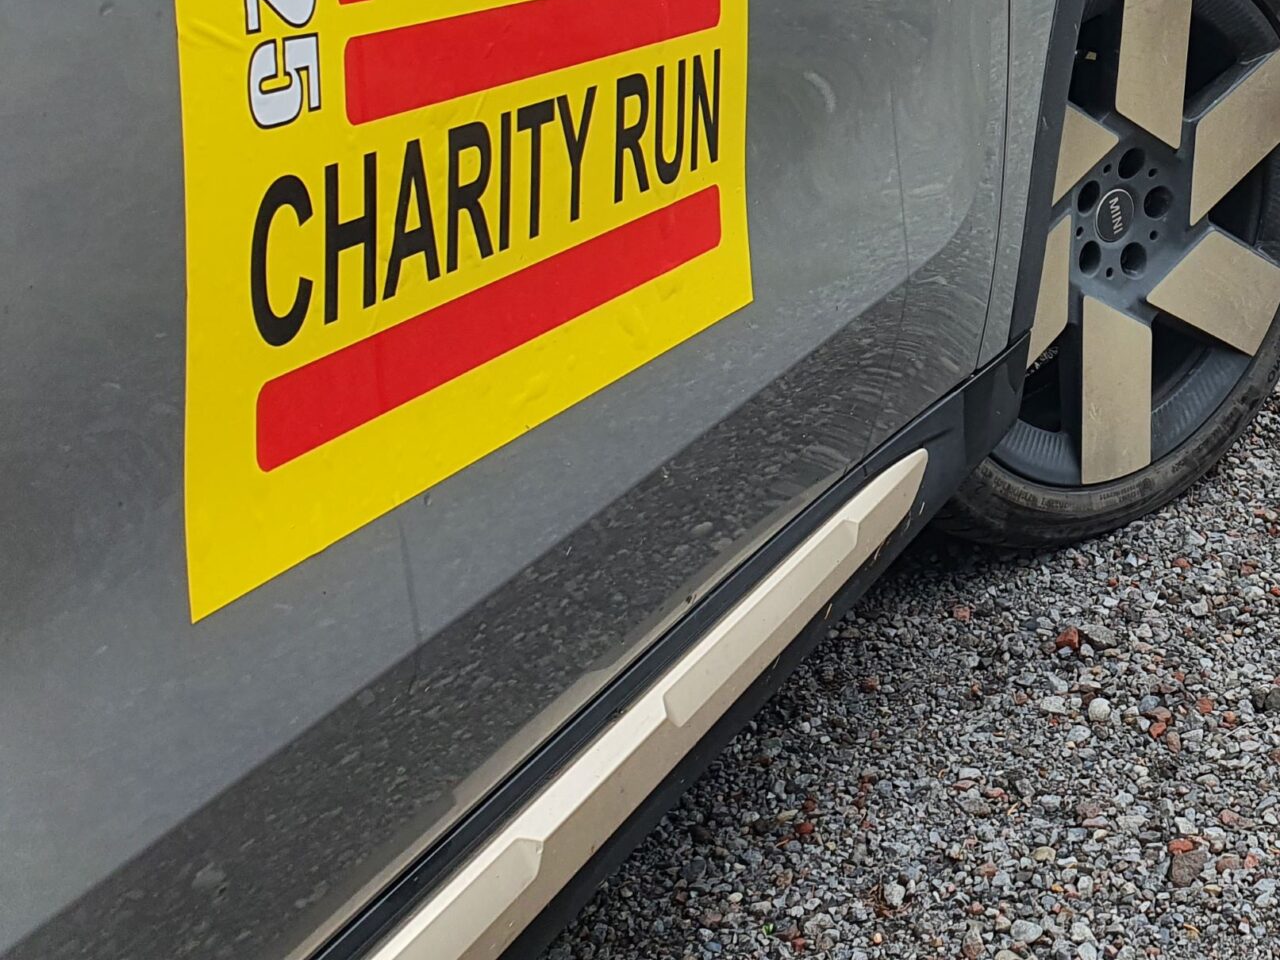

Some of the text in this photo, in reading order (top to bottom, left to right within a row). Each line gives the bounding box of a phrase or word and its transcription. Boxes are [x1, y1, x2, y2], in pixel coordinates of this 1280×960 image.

[250, 48, 721, 347] CHARITY RUN
[1108, 196, 1124, 235] MINI
